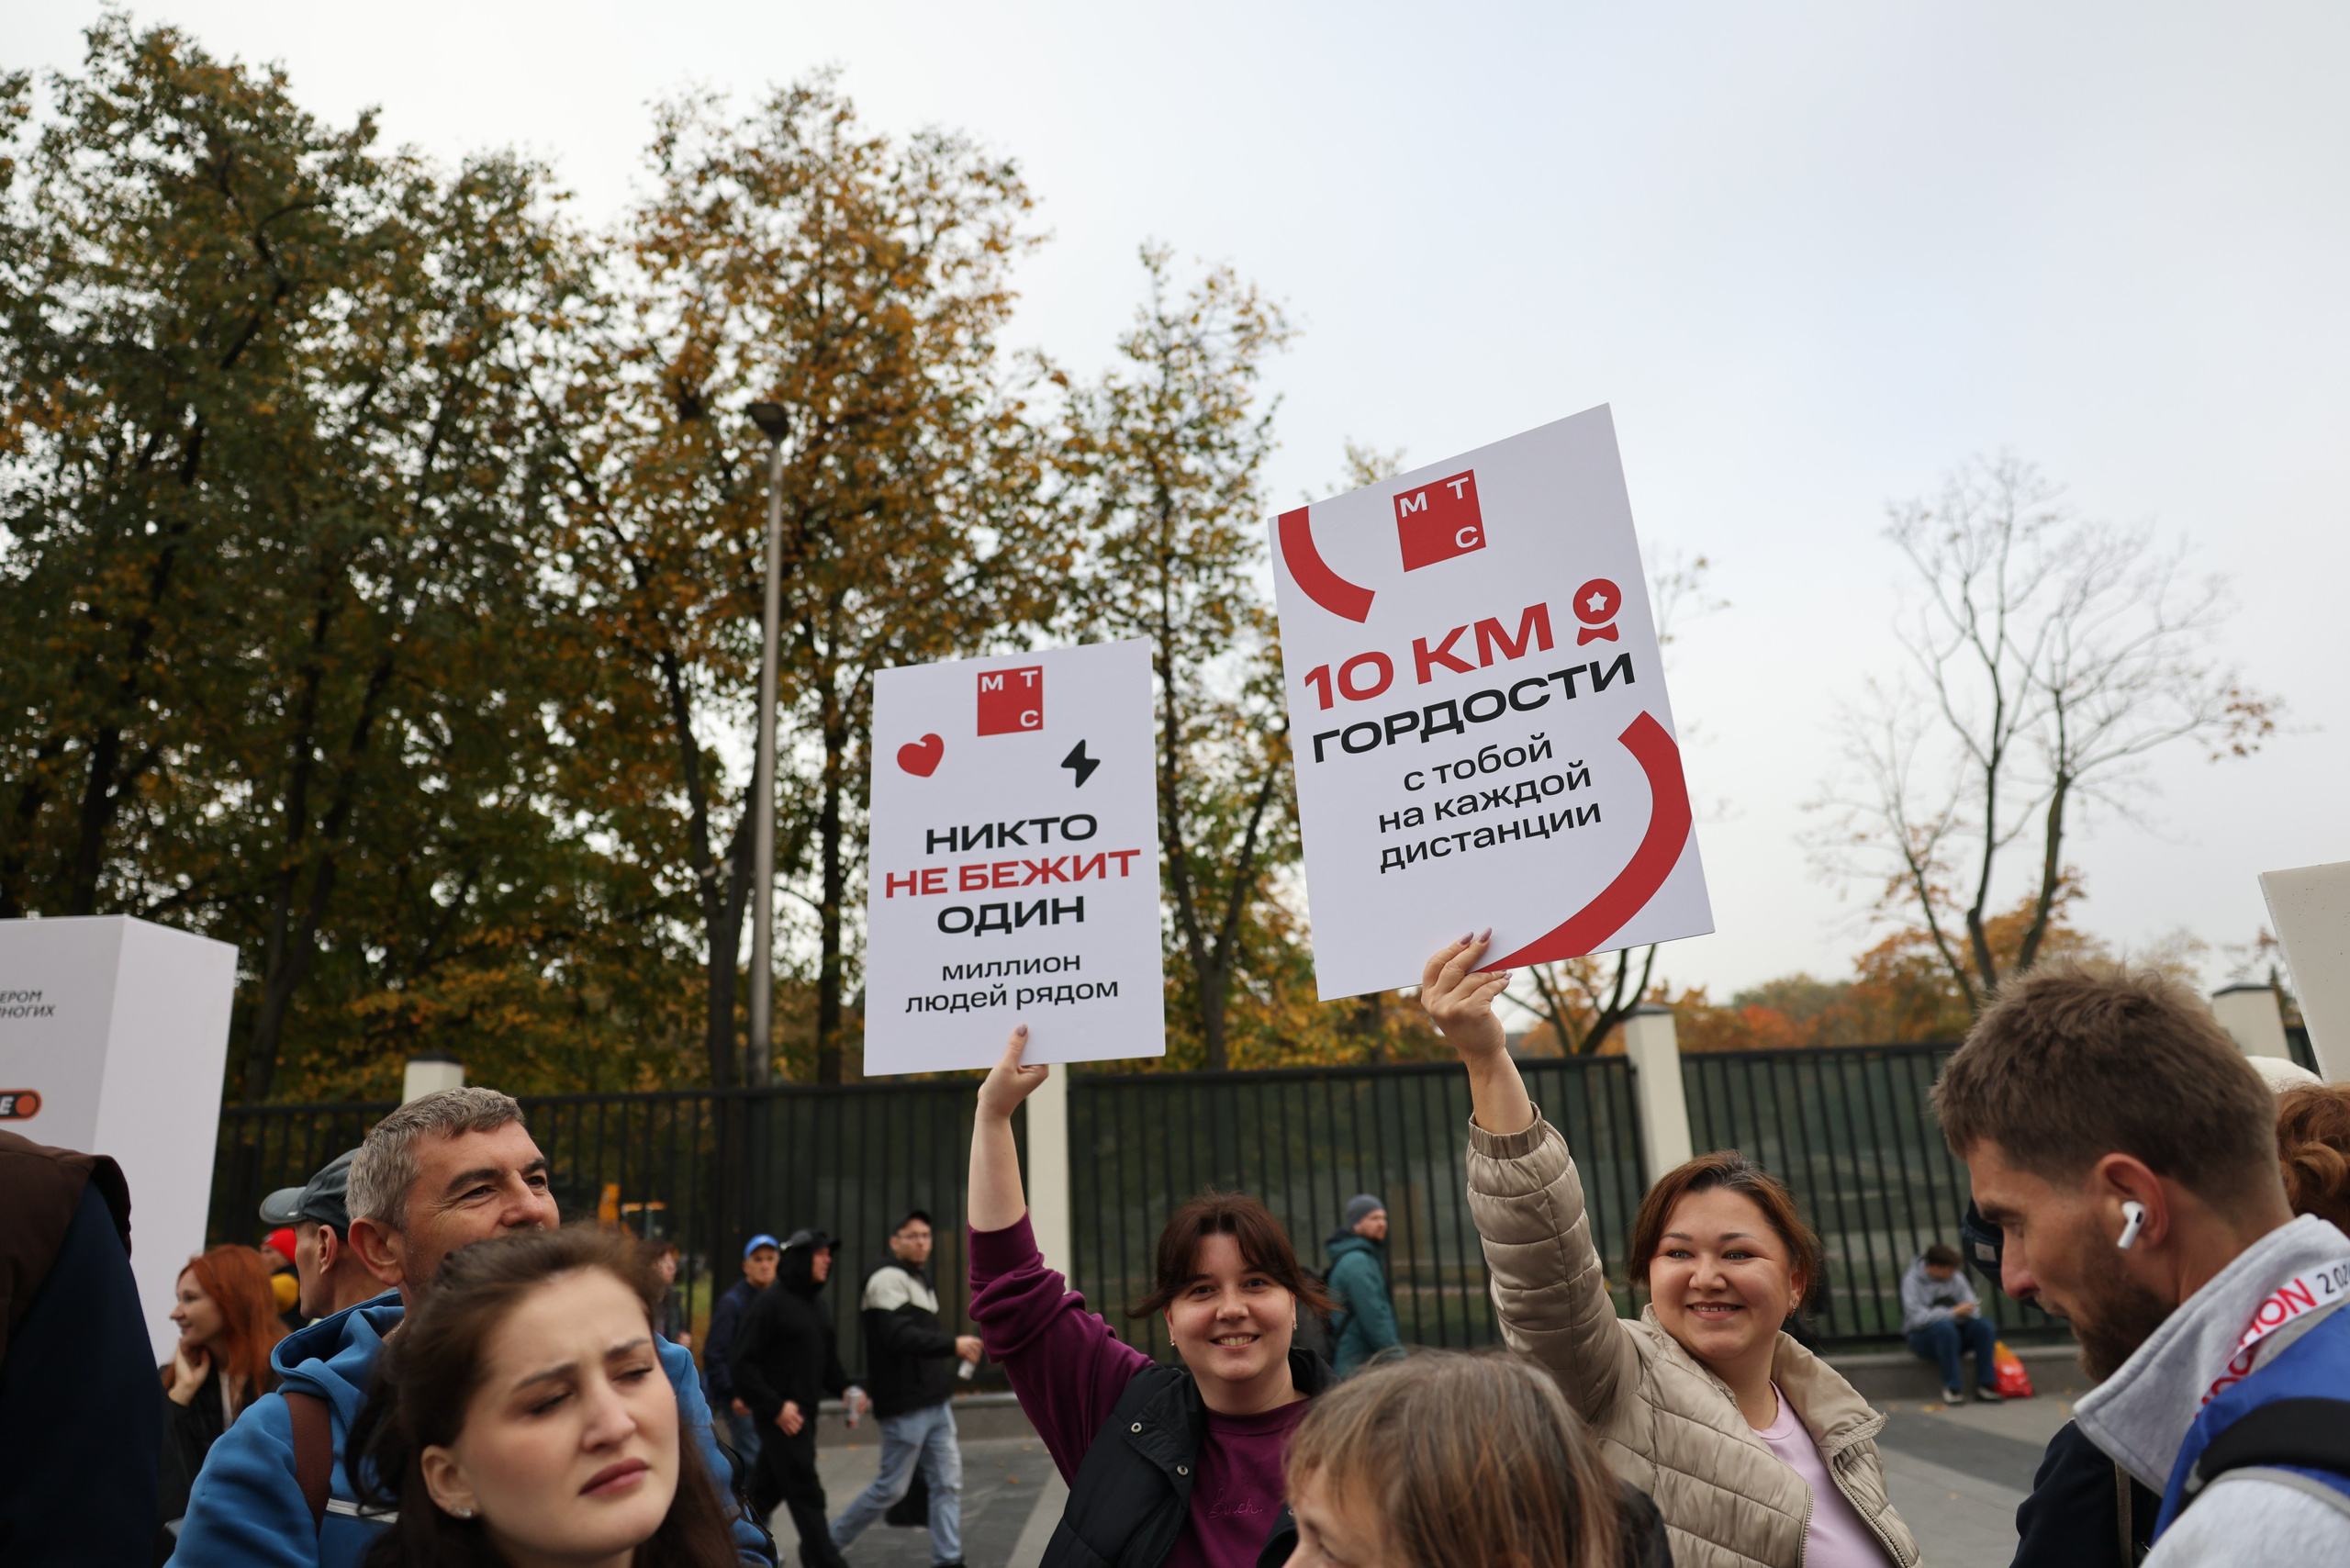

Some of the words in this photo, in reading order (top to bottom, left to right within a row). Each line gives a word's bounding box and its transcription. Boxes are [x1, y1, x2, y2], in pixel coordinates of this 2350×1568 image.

[1304, 651, 1393, 711] 10
[1413, 602, 1554, 685] КМ
[1313, 652, 1636, 764] ГОРДОСТИ
[1404, 771, 1426, 791] с
[1431, 733, 1553, 784] тобой
[1379, 806, 1425, 834] на
[1434, 760, 1592, 822] каждой
[926, 813, 1098, 855] НИКТО
[1380, 802, 1602, 875] дистанции
[886, 868, 948, 899] НЕ
[959, 849, 1141, 891] БЕЖИТ
[937, 895, 1084, 937] ОДИН
[942, 955, 1080, 981] миллион
[905, 983, 1007, 1014] людей
[1016, 980, 1118, 1011] рядом
